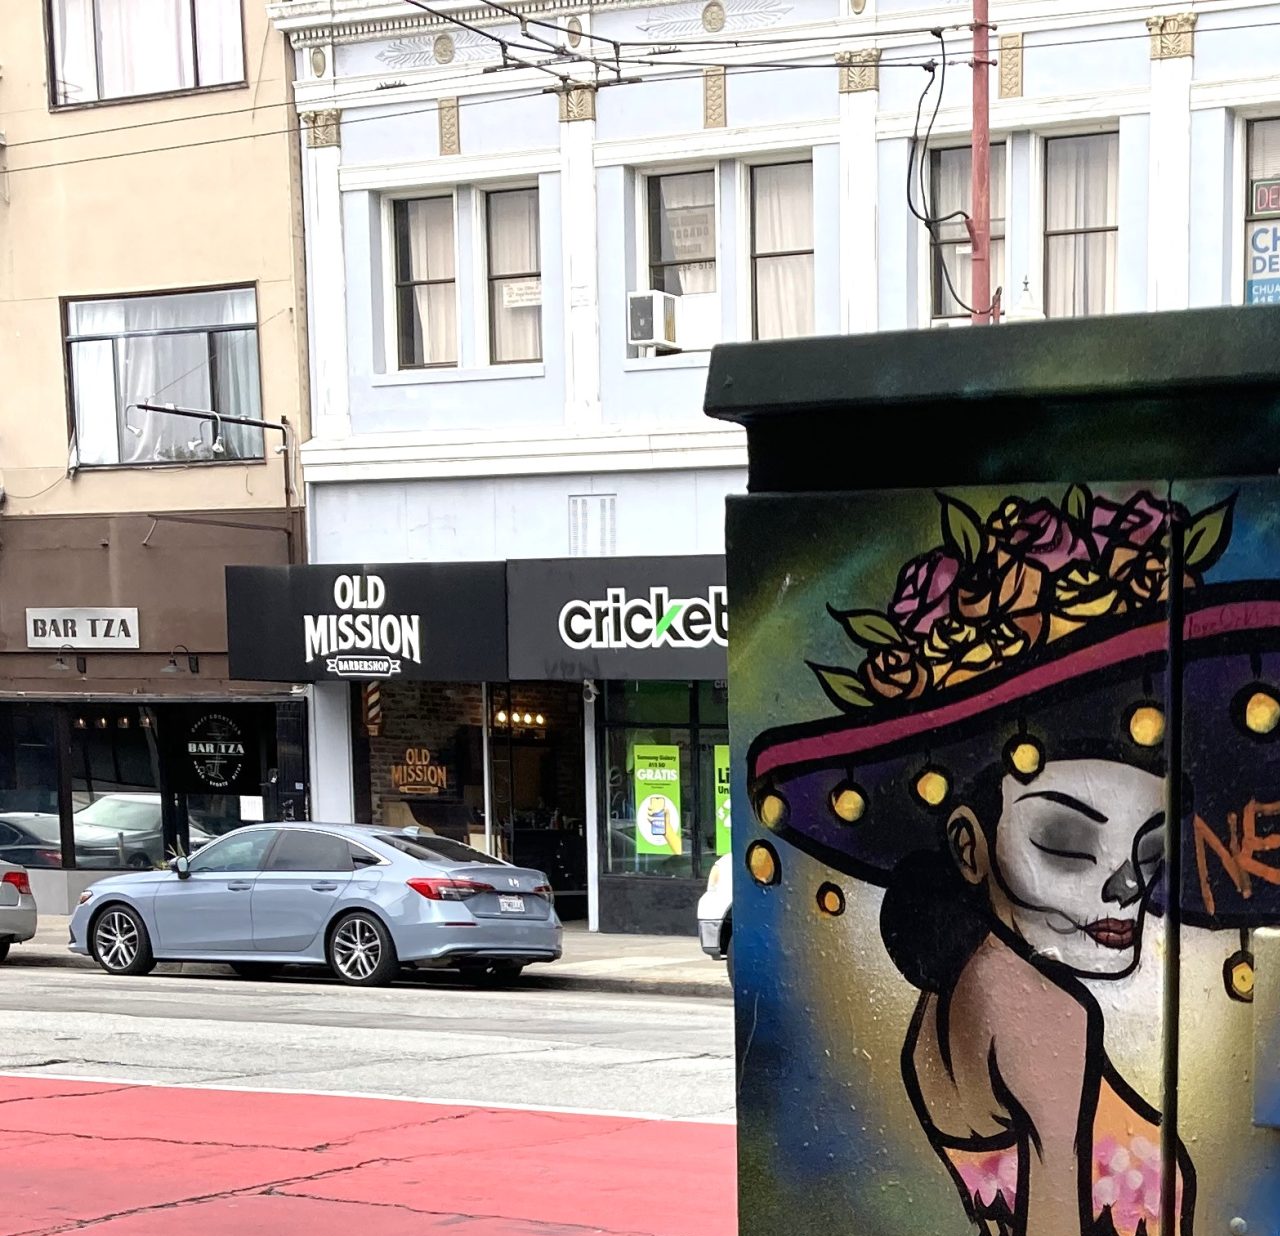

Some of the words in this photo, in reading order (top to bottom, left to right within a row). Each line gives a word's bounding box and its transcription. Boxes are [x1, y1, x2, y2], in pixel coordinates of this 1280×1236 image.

[333, 574, 385, 609] OLD
[558, 585, 729, 650] cricket
[32, 618, 77, 638] BAR
[86, 618, 132, 638] TZA
[303, 613, 421, 664] MISSION
[338, 660, 389, 672] BARBERSHOP
[188, 743, 215, 753] BAR
[217, 743, 245, 754] TZA
[406, 748, 431, 765] OLD
[391, 764, 447, 789] MISSION
[637, 769, 678, 781] GRATIS
